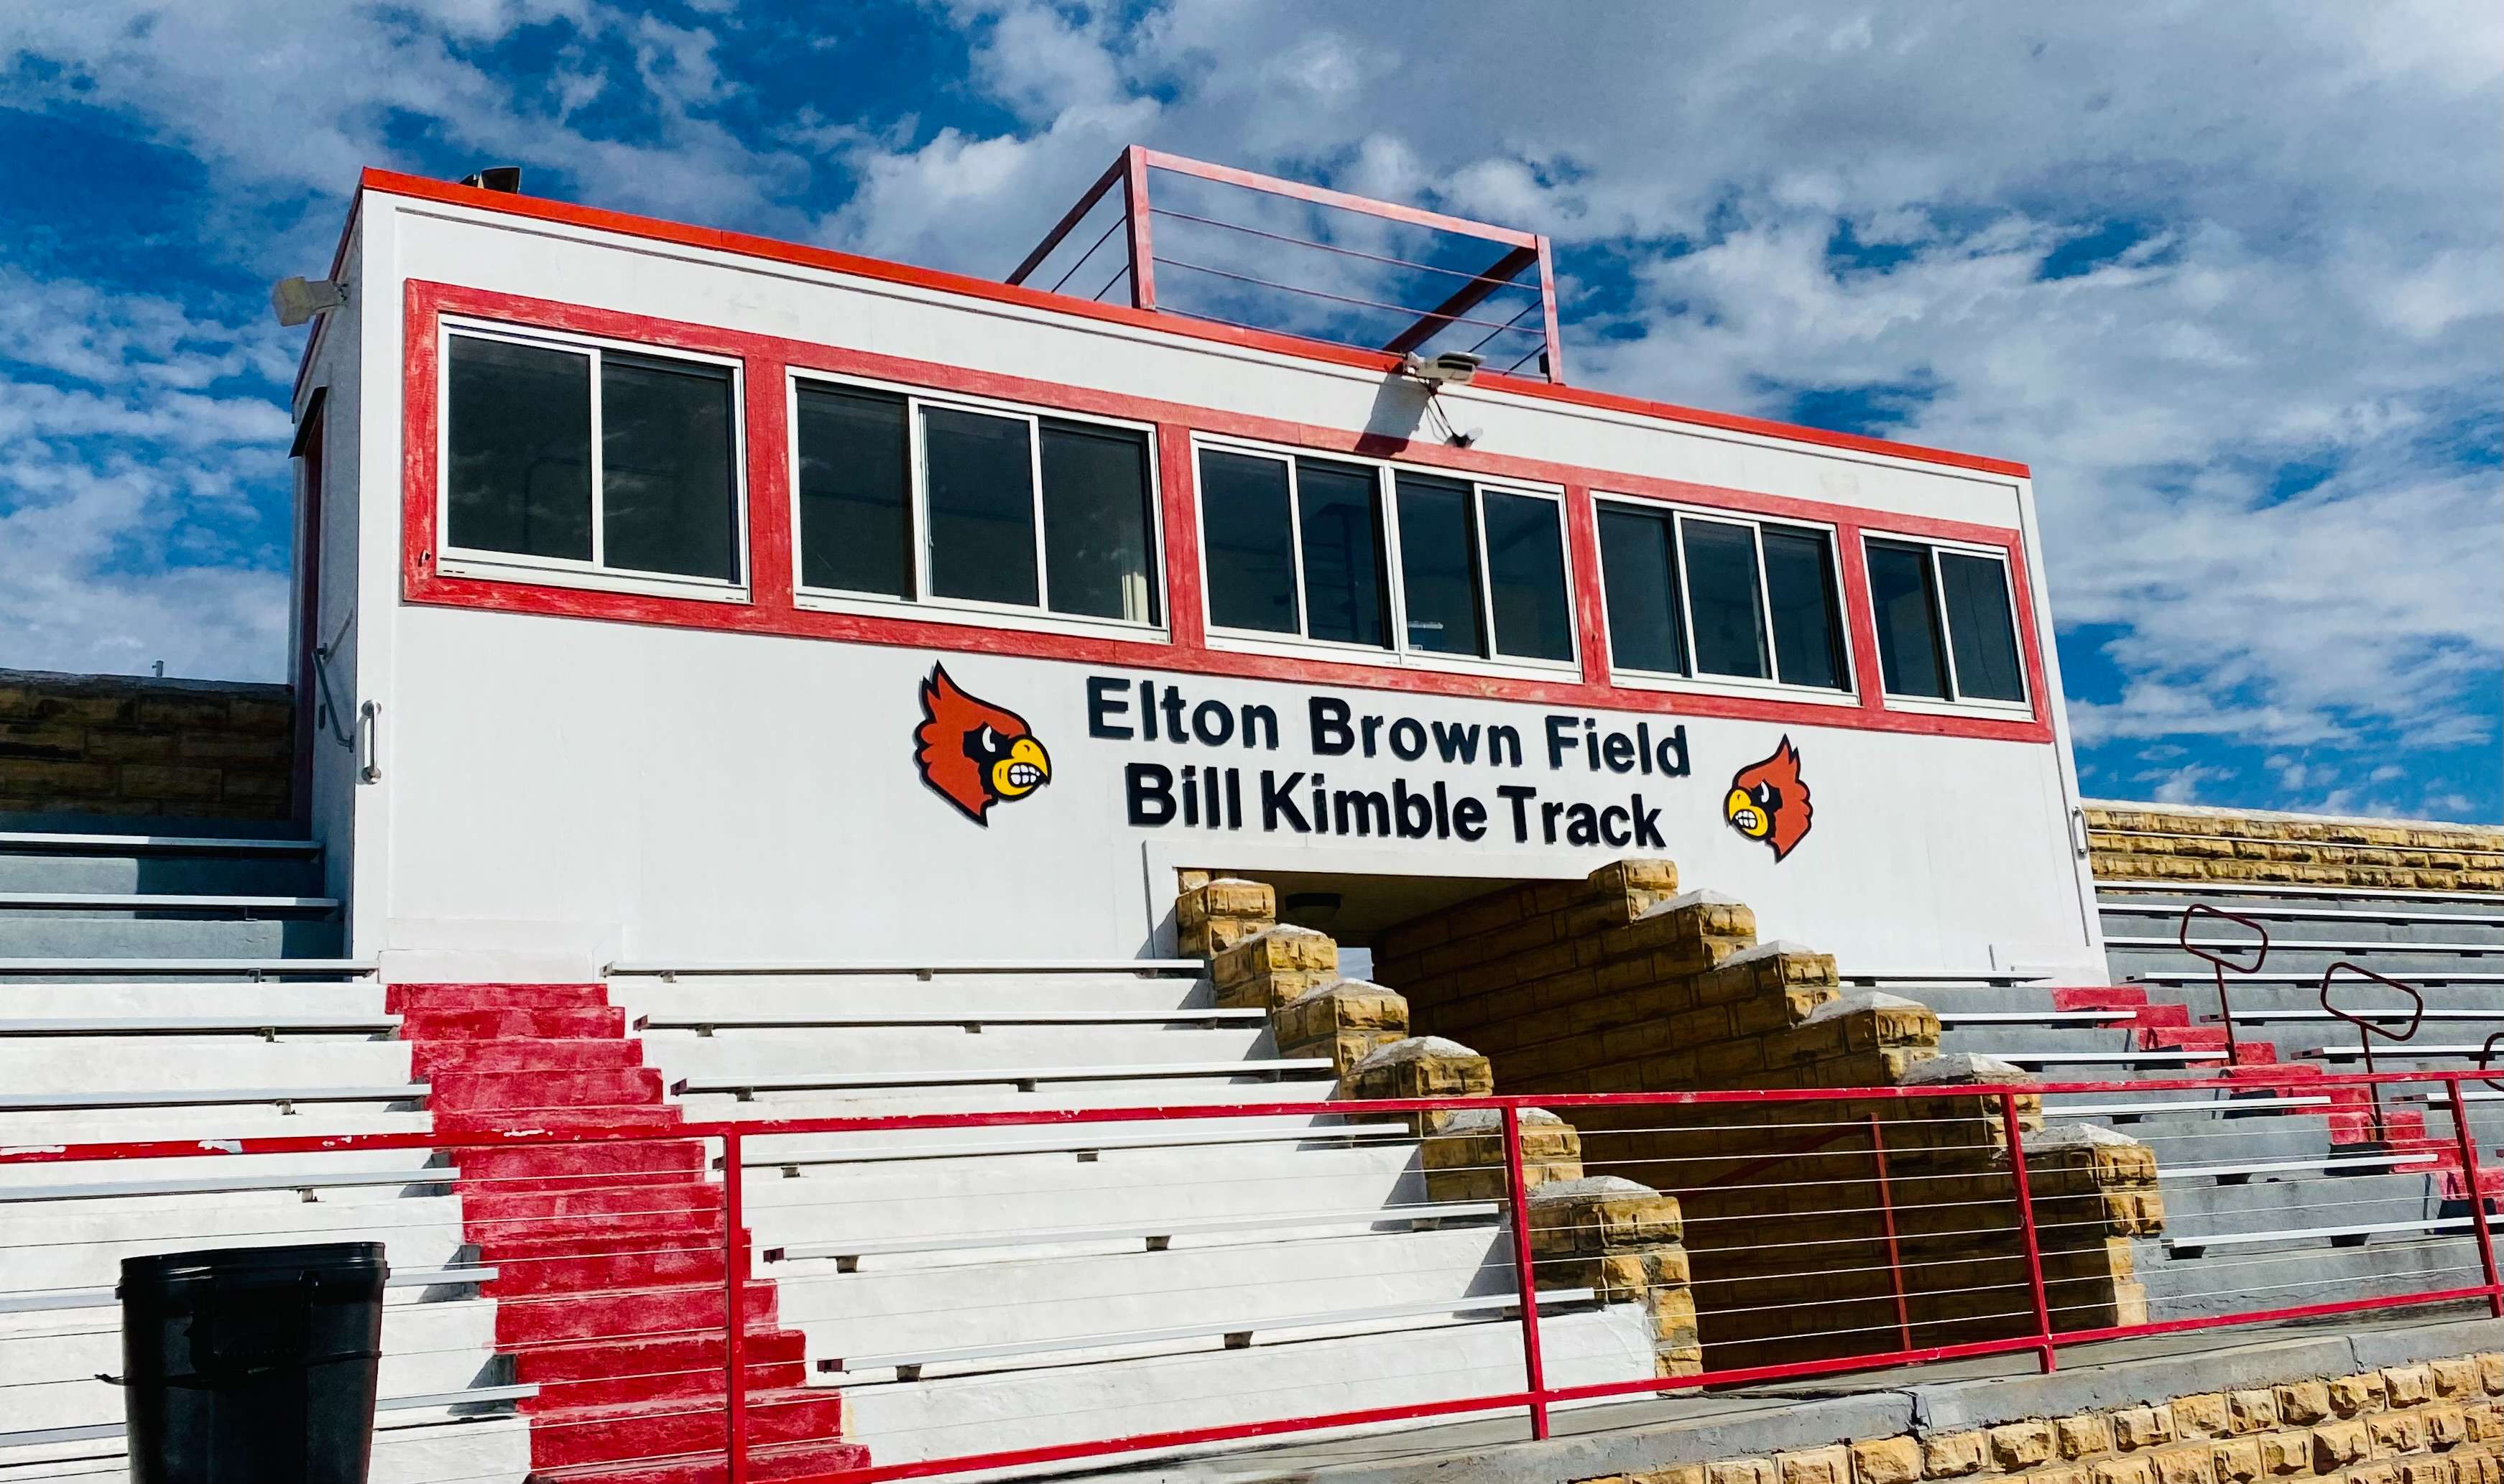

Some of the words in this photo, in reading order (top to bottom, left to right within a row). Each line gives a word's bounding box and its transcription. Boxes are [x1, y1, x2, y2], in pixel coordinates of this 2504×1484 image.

[1086, 675, 1279, 751] Elton
[1308, 696, 1523, 769] Brown
[1544, 715, 1691, 778] Field
[1125, 762, 1242, 830] Bill
[1260, 769, 1487, 843] Kimble
[1496, 784, 1667, 849] Track
